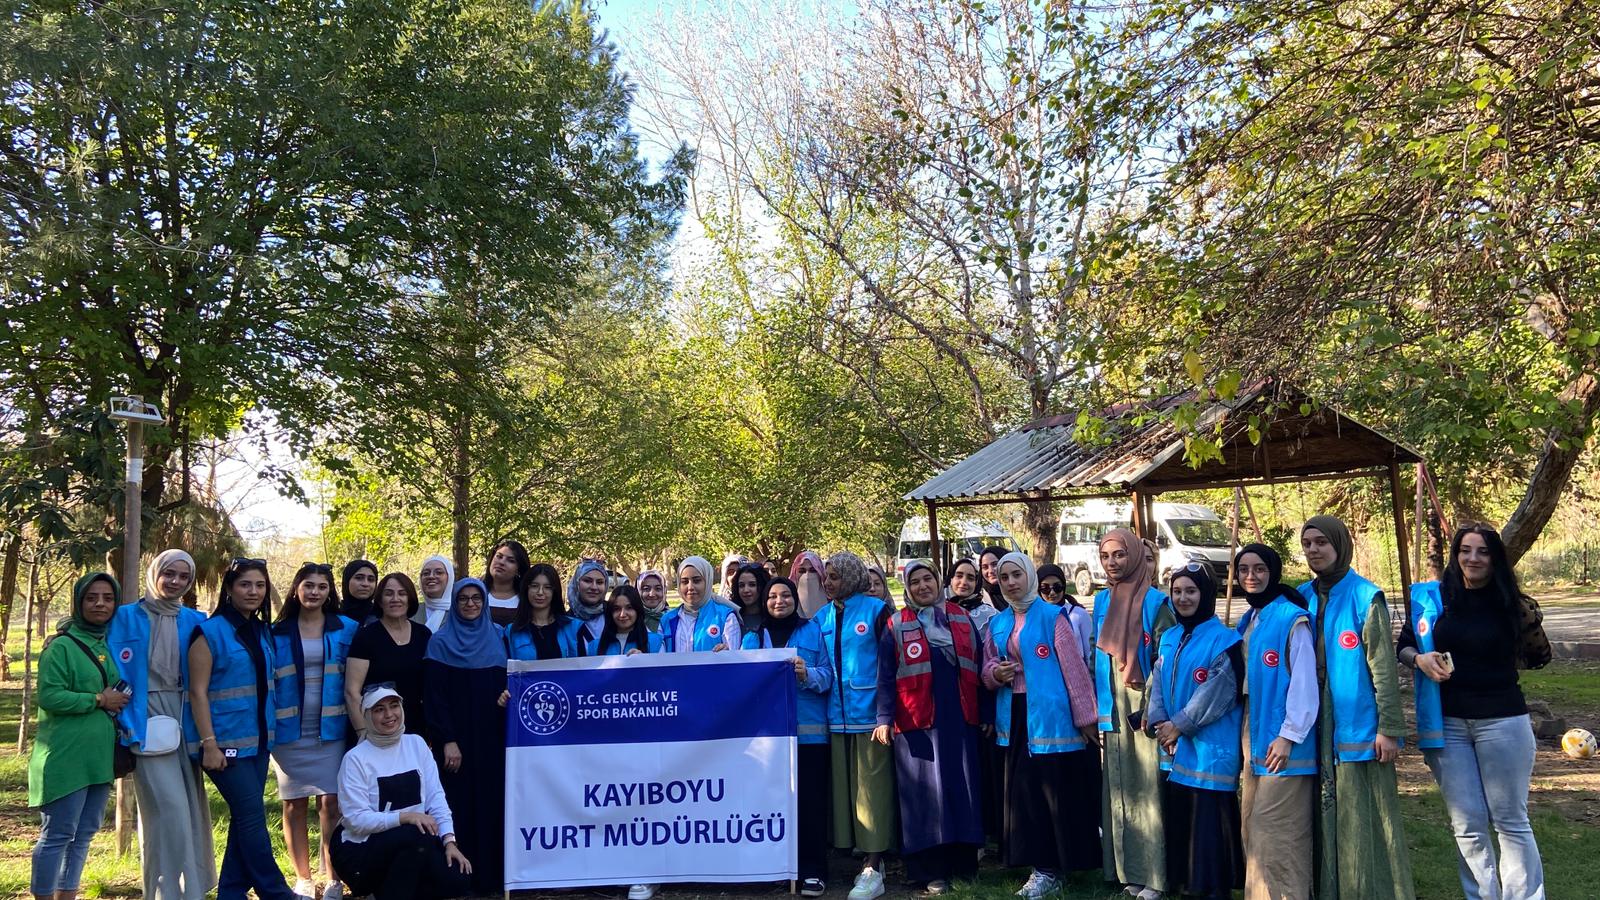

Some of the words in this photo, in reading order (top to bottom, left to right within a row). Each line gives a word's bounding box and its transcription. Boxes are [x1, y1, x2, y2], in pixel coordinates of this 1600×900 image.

[576, 694, 599, 705] T.C.
[602, 689, 658, 706] GENÇLİK
[661, 690, 678, 702] VE
[577, 708, 609, 719] SPOR
[612, 703, 678, 719] BAKANLIĞI
[584, 778, 725, 808] KAYIBOYU
[520, 824, 596, 851] YURT
[604, 812, 785, 847] MÜDÜRLÜĞÜ
